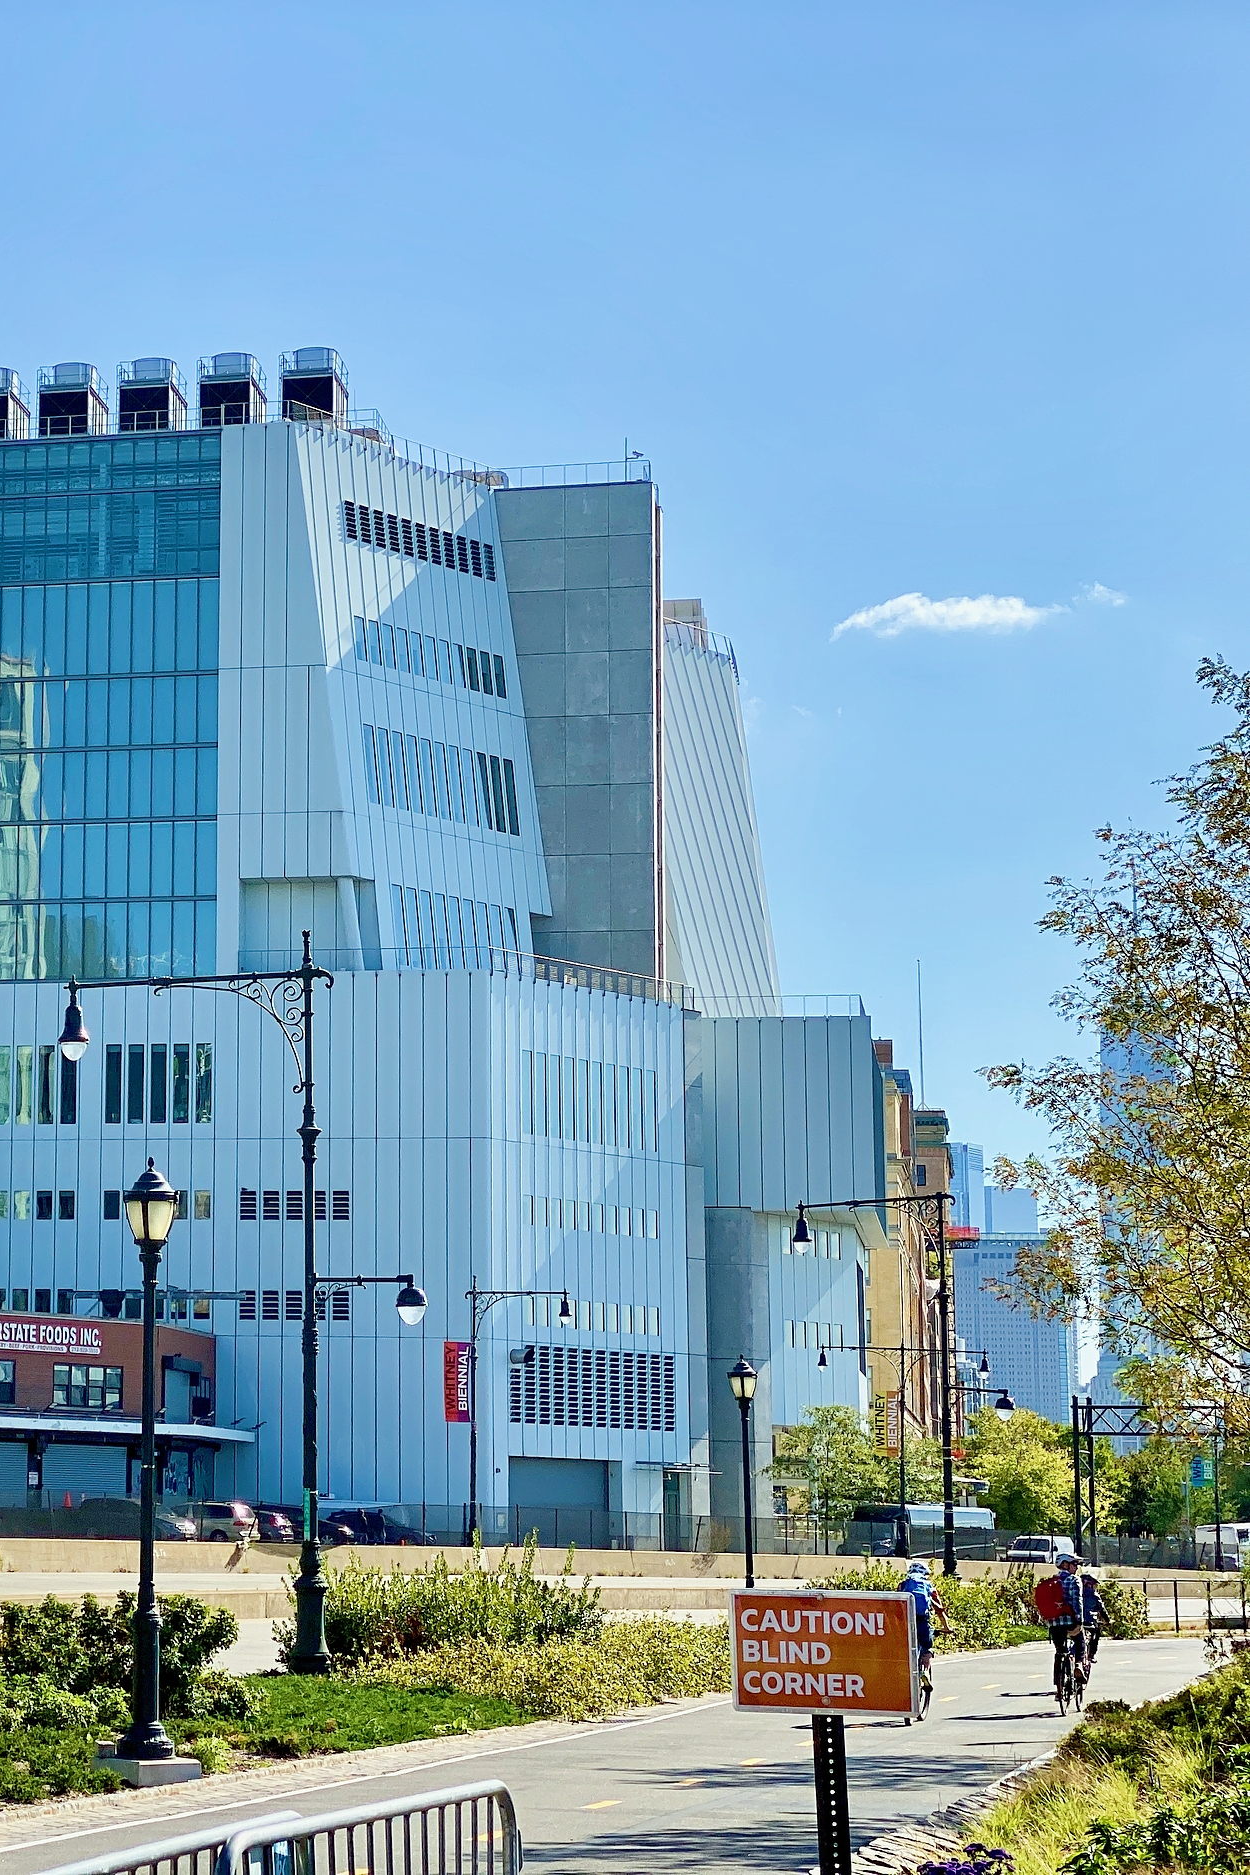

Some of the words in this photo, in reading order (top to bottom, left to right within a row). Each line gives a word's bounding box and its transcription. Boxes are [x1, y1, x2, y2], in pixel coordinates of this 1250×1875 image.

[39, 1325, 77, 1345] FOODS
[80, 1328, 102, 1347] INC.
[445, 1346, 456, 1410] WHITNEY
[457, 1346, 469, 1411] BIENNIAL
[875, 1394, 886, 1447] WHITNEY
[887, 1395, 898, 1448] BIENNIAL
[740, 1608, 885, 1636] CAUTION!
[741, 1639, 832, 1665] BLIND
[743, 1670, 865, 1698] CORNER
